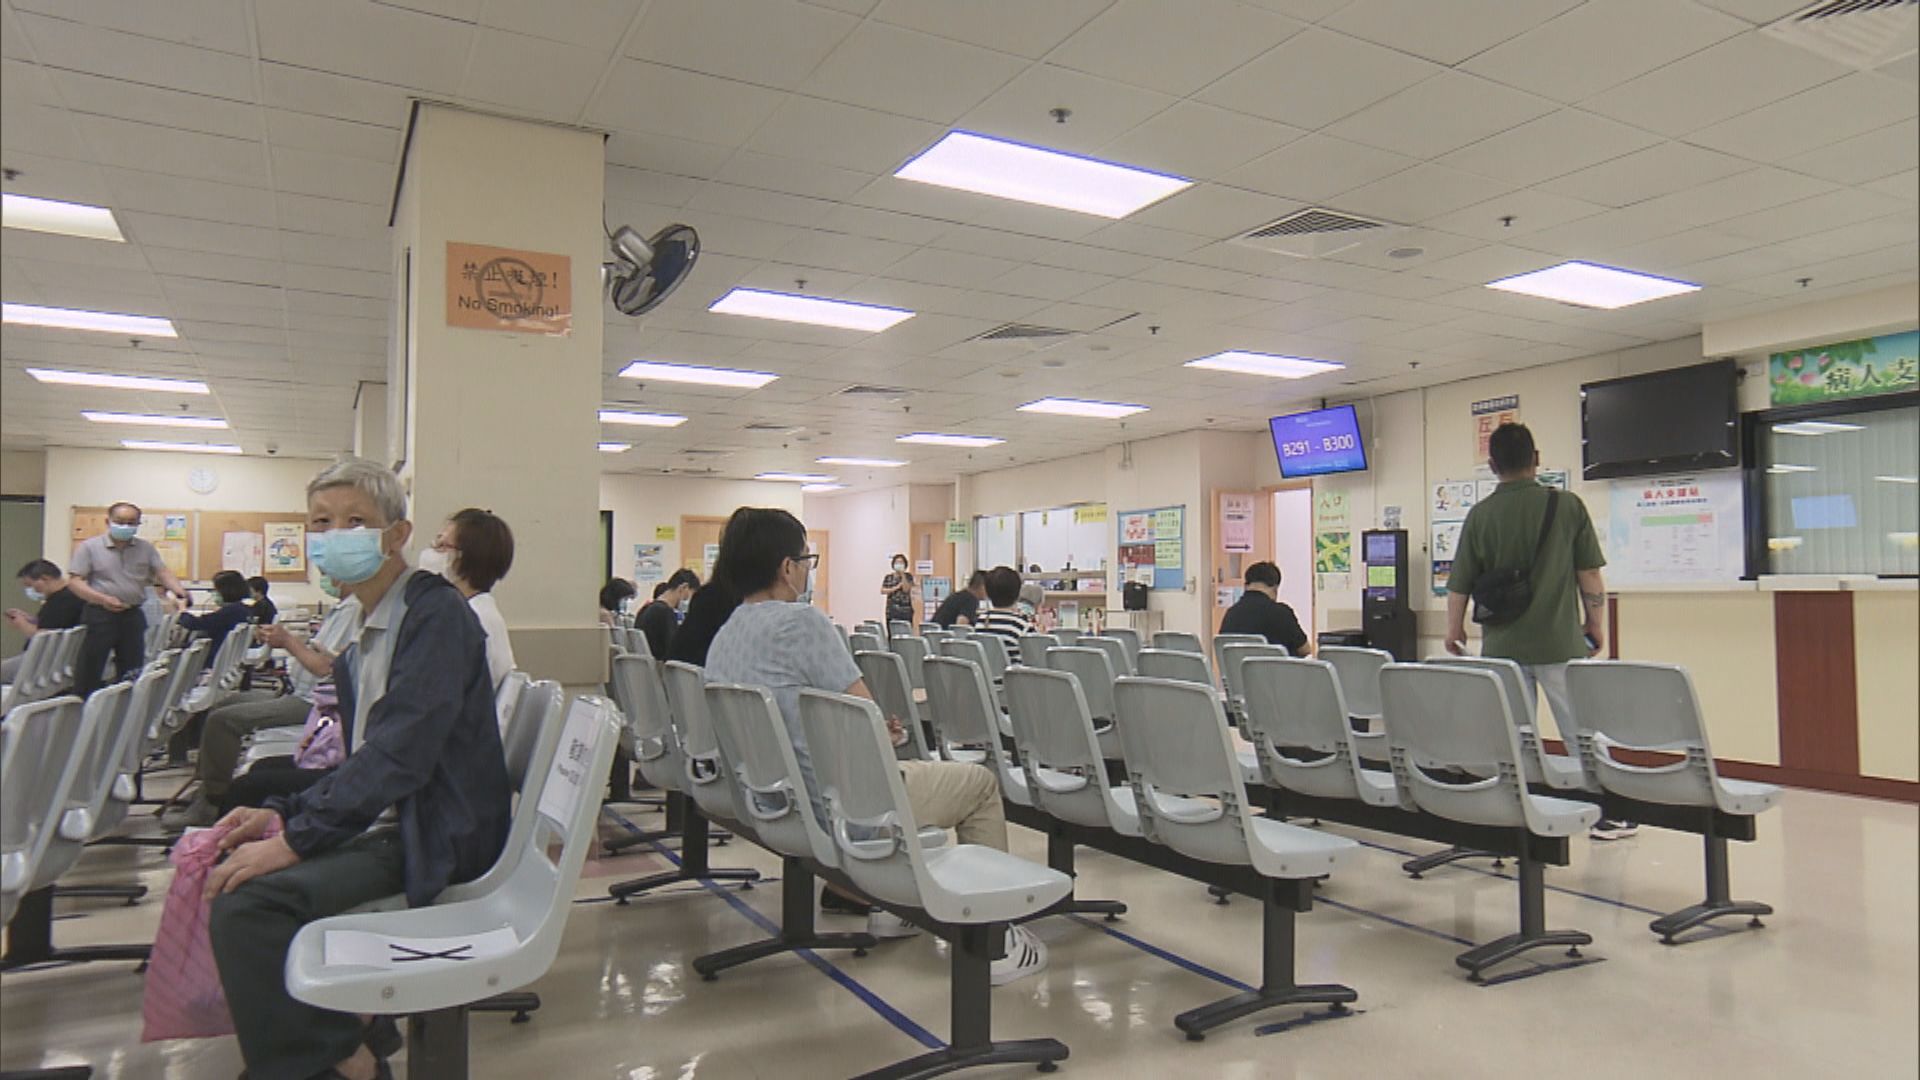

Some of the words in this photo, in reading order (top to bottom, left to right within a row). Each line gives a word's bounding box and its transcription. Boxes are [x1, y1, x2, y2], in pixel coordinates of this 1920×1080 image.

[458, 295, 481, 310] No
[487, 297, 560, 317] Smoking!
[1282, 440, 1311, 457] B291
[1322, 434, 1354, 452] B300
